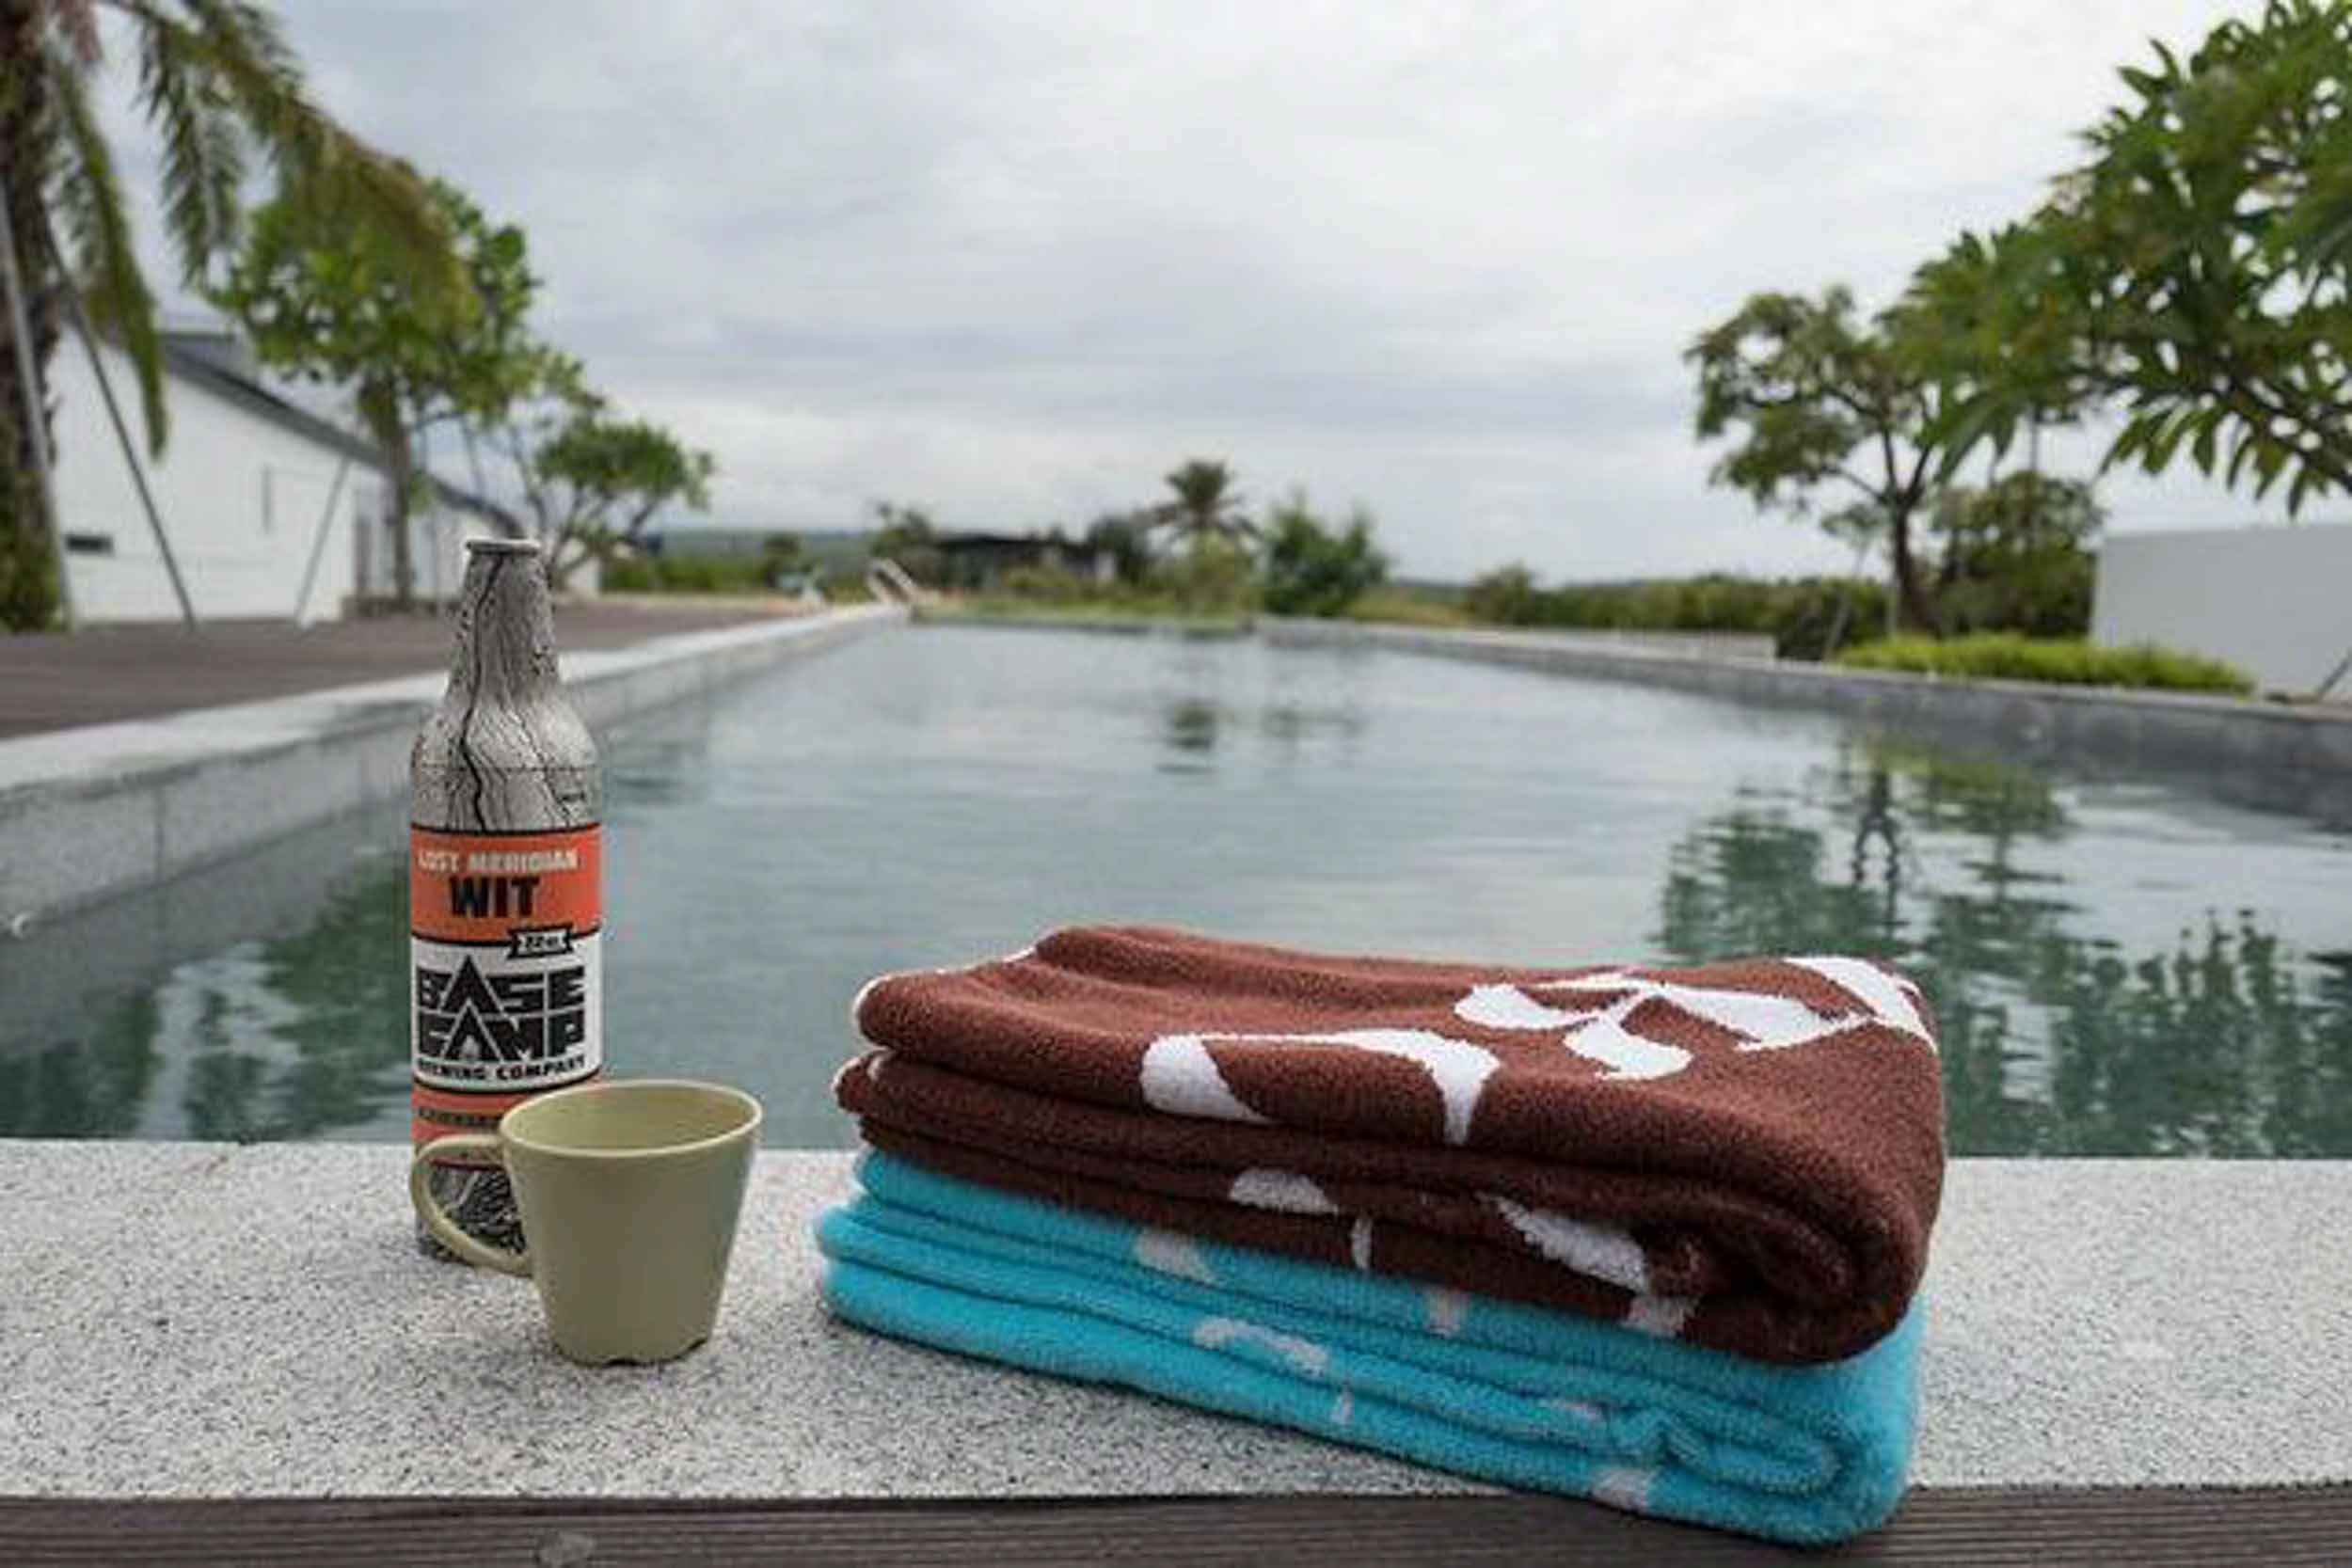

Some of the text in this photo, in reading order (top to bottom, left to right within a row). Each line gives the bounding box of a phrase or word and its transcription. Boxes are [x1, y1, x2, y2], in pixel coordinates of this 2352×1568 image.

[450, 876, 540, 917] WIT
[417, 955, 585, 1013] BASE
[419, 1003, 585, 1061] CAMP
[496, 1054, 584, 1080] COMPANY
